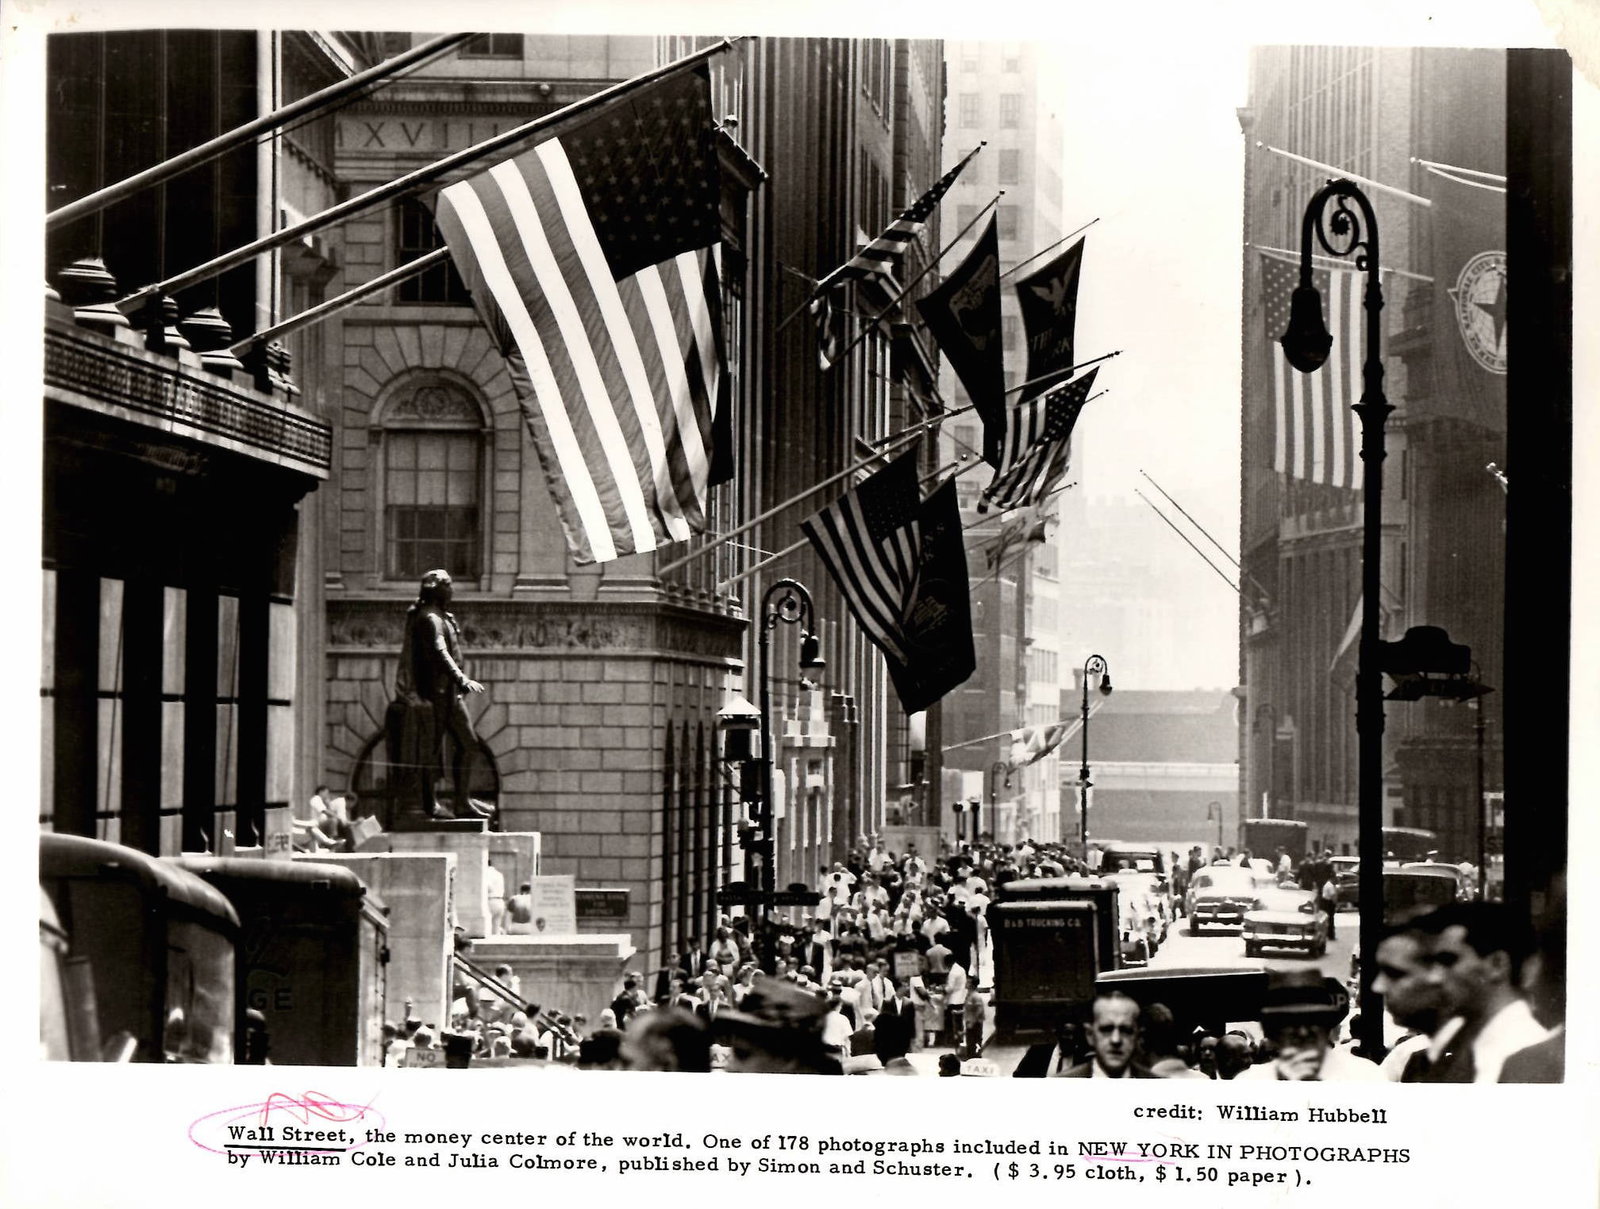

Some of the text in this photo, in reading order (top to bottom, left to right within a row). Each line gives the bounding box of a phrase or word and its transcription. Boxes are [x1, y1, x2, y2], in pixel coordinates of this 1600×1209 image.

[1026, 918, 1065, 928] TRUCKING
[416, 1052, 436, 1063] NO
[966, 1063, 994, 1074] TAXI
